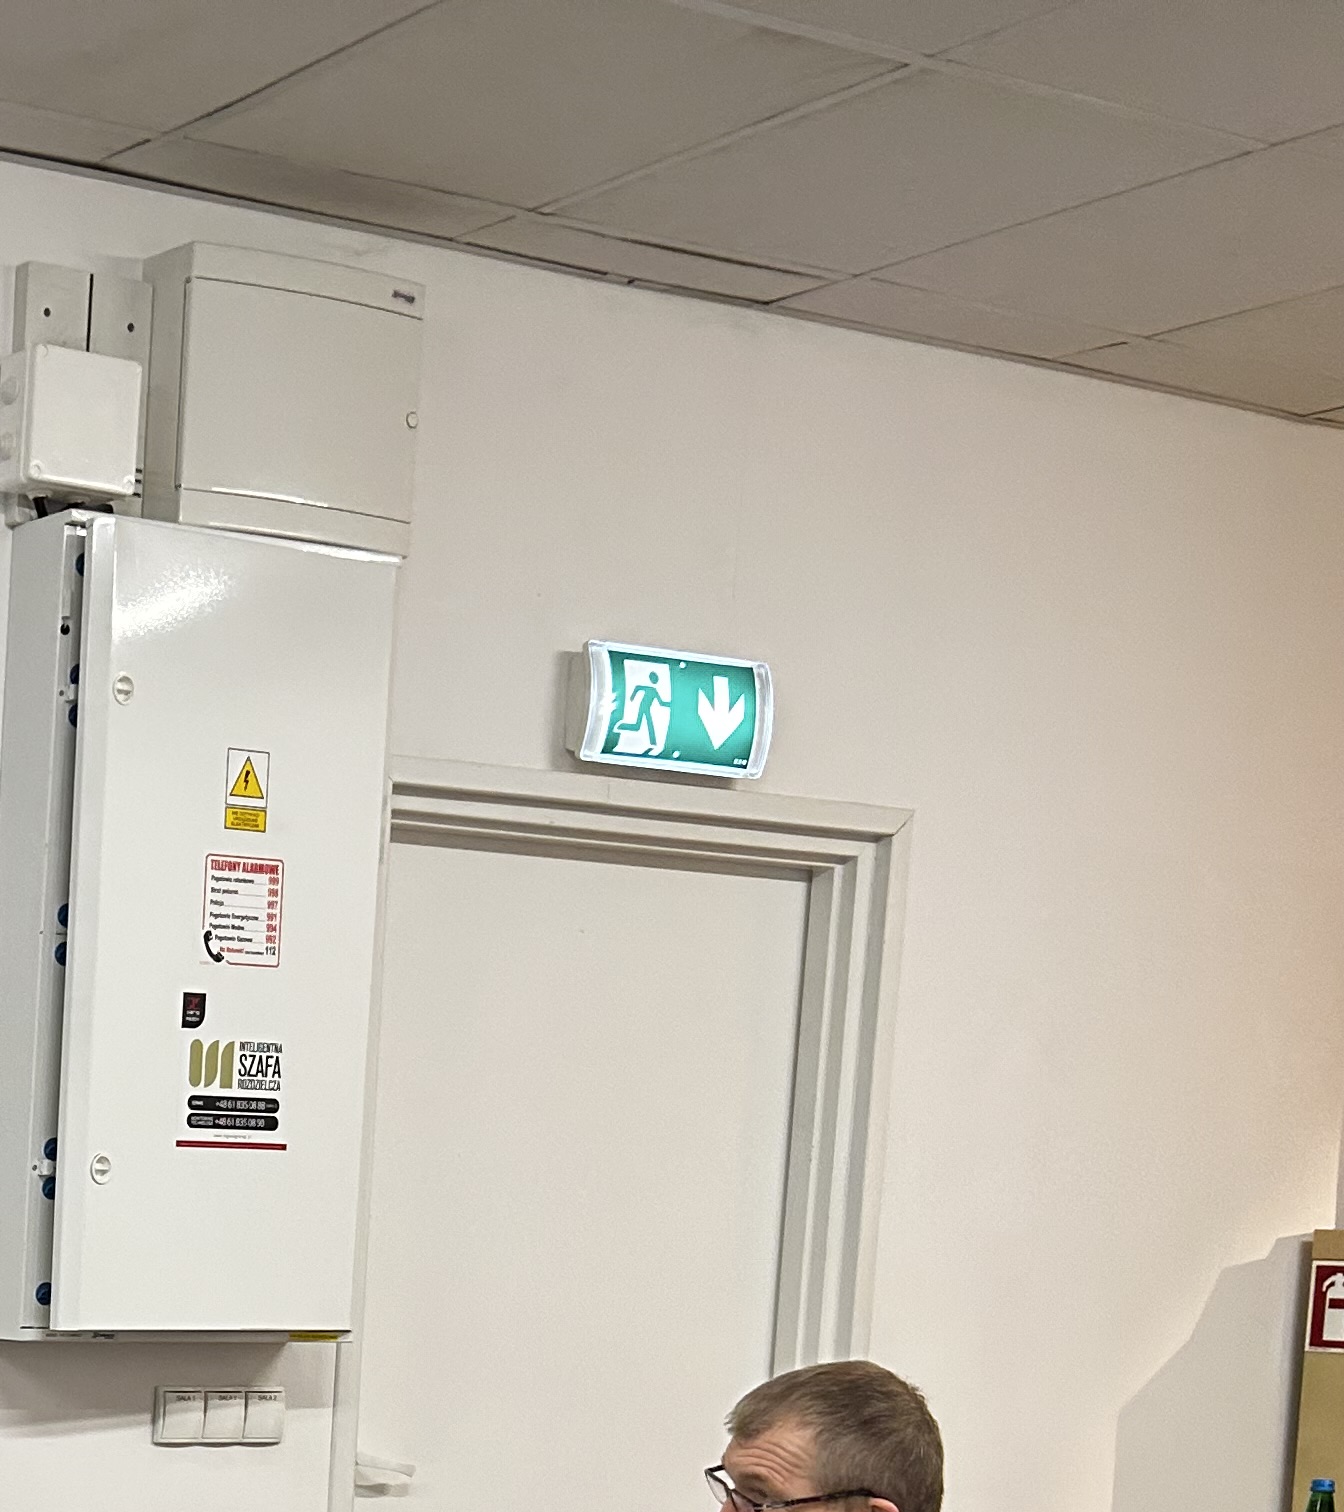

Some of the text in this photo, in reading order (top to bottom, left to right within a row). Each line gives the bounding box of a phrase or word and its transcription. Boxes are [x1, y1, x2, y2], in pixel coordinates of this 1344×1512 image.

[211, 859, 280, 876] TELEFONY ALARMOWE
[265, 946, 277, 956] 112
[239, 1041, 283, 1054] INTELIGENTNA
[238, 1054, 282, 1079] SZAFA
[237, 1079, 281, 1092] ROZDZIELCZA
